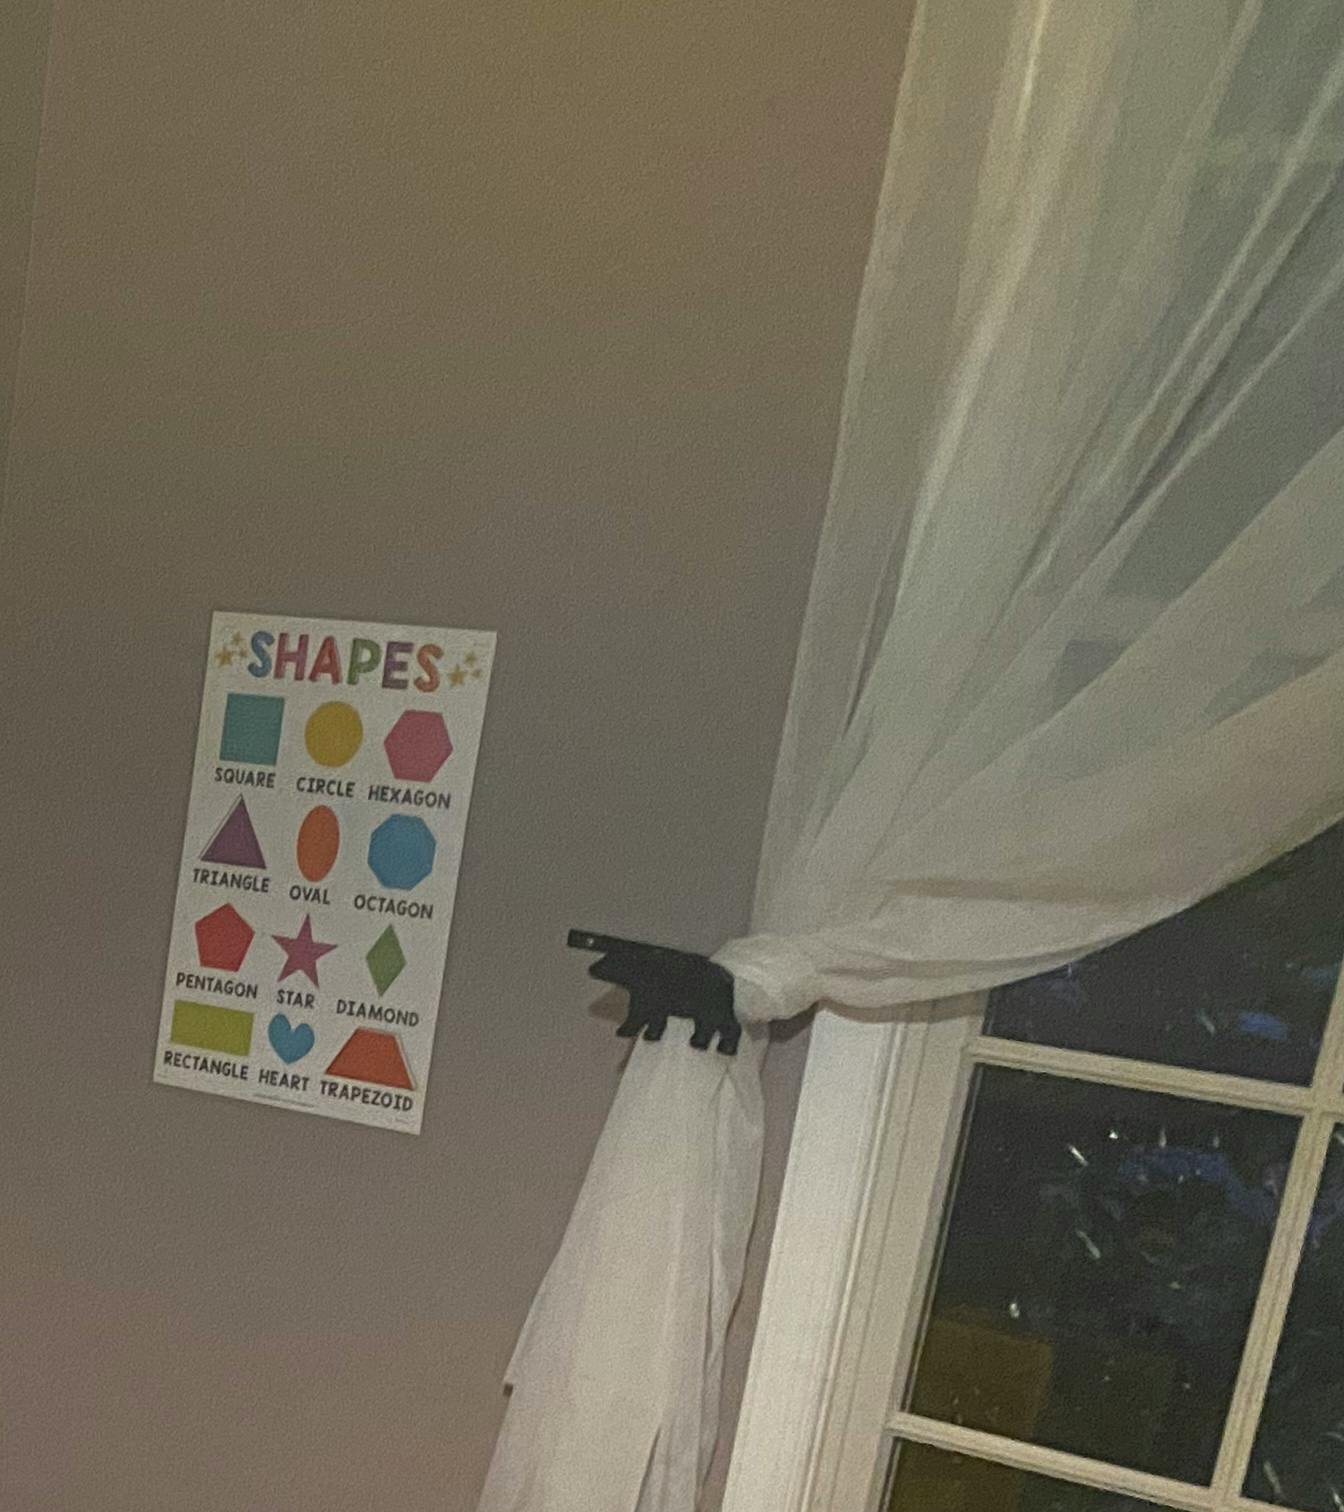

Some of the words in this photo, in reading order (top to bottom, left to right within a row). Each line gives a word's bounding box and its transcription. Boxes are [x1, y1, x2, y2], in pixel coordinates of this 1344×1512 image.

[247, 631, 444, 693] SHAPES
[214, 767, 277, 789] SQUARE
[296, 777, 356, 798] CIRCLE
[367, 785, 452, 810] HEXAGON
[192, 868, 270, 893] TRIANGLE
[289, 885, 331, 905] OVAL
[354, 895, 433, 920] OCTAGON
[175, 971, 259, 999] PENTAGON
[276, 989, 315, 1009] STAR
[336, 999, 420, 1027] DIAMOND
[163, 1050, 249, 1081] RECTANGLE
[258, 1069, 310, 1092] HEART
[319, 1080, 414, 1112] TRAPEZOID
